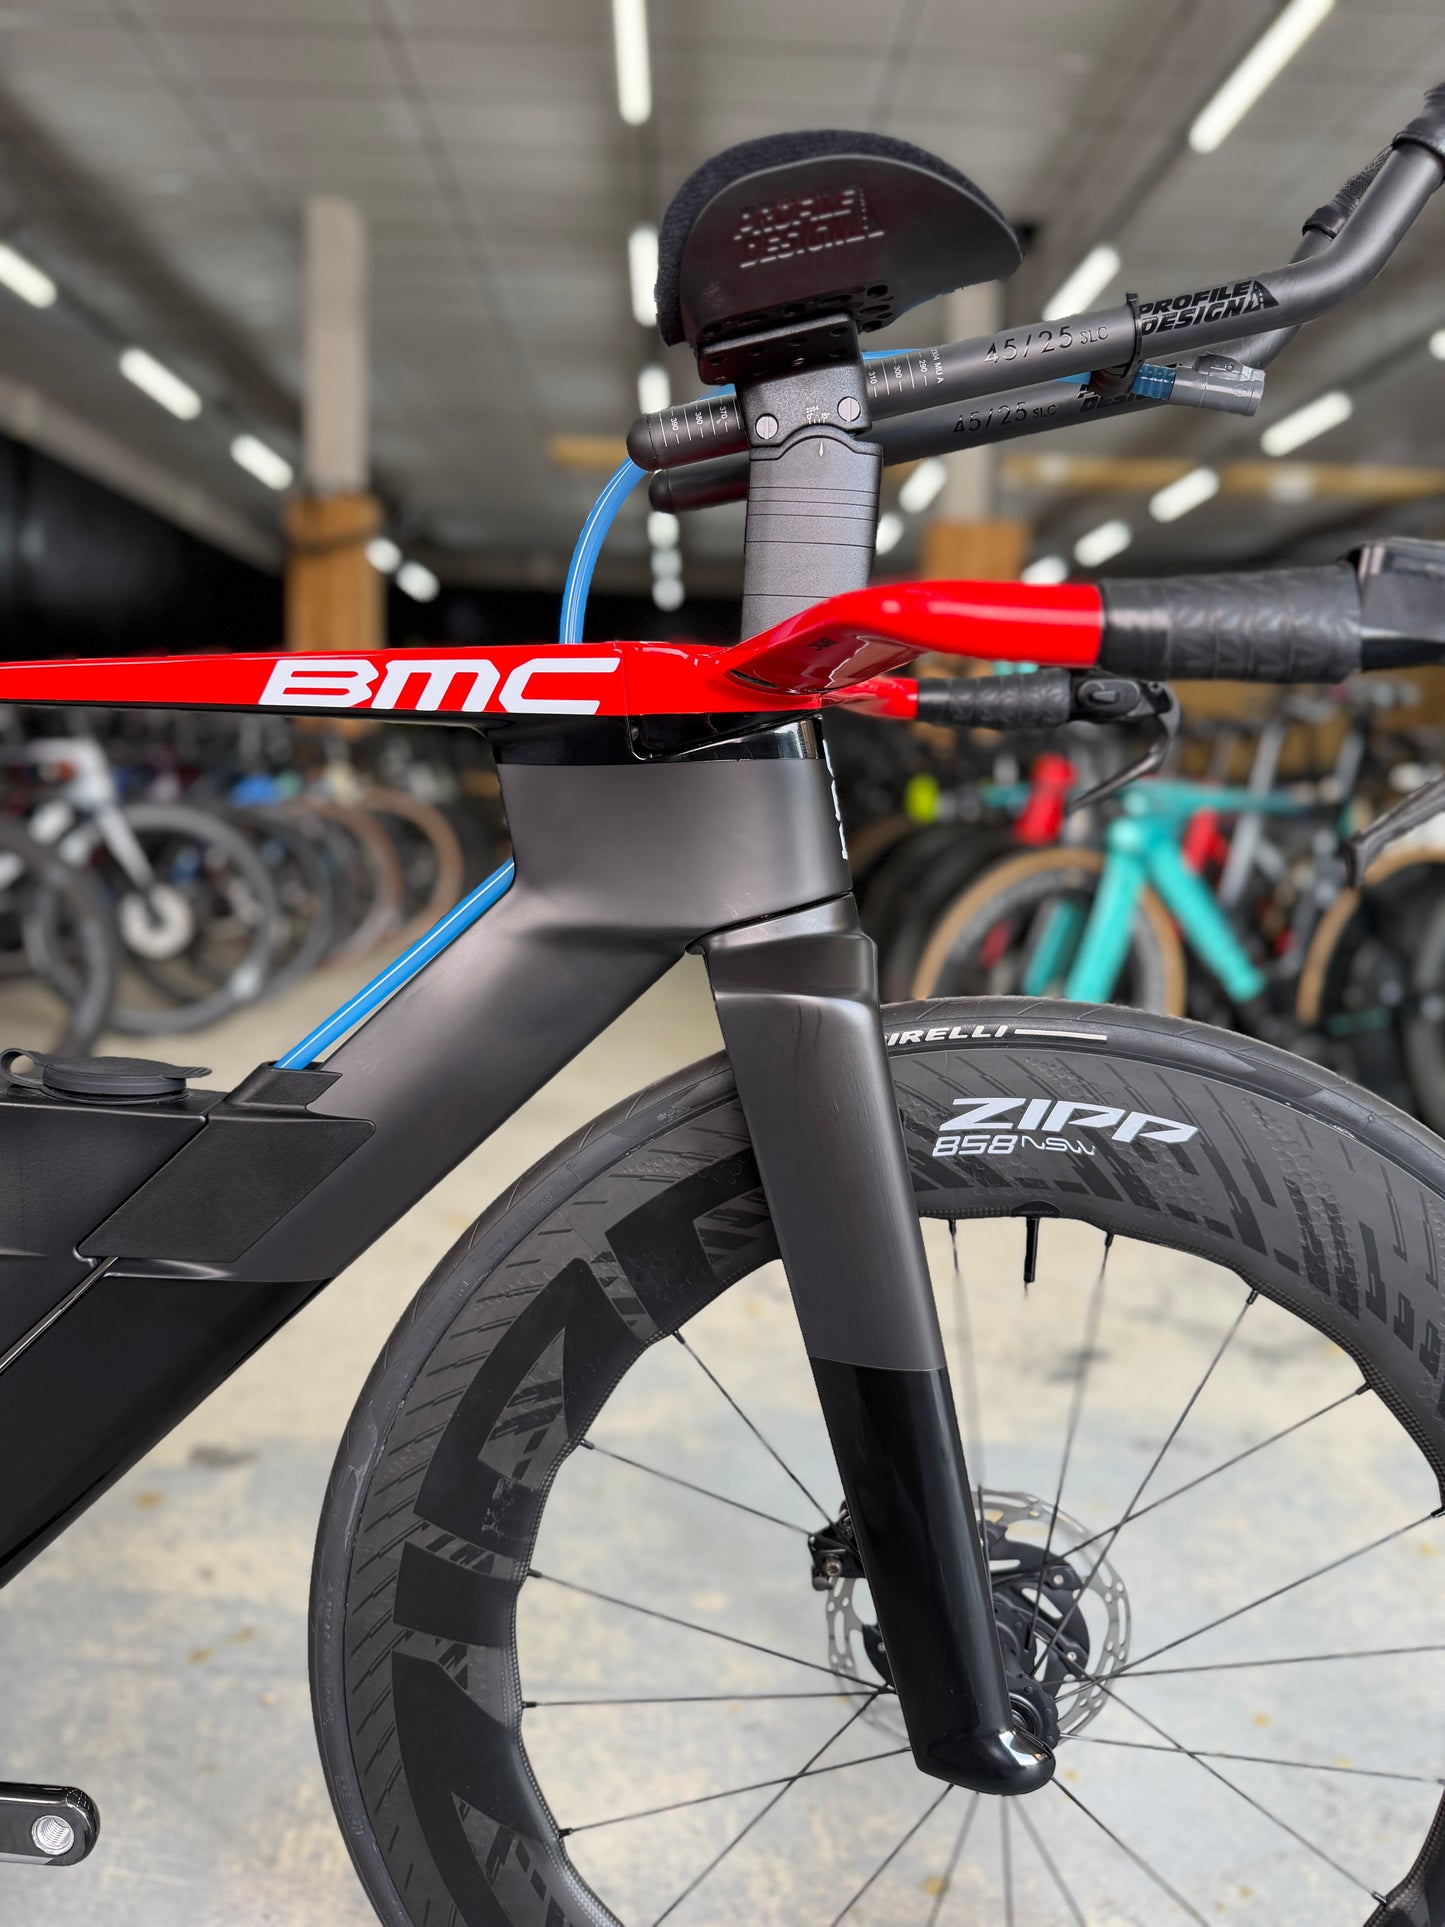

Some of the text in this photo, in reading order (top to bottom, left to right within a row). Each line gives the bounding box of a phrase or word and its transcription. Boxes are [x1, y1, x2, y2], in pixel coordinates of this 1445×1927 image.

[1138, 281, 1252, 316] PROFILE
[1141, 298, 1246, 336] DESIGN
[983, 325, 1108, 363] 45/25 SLC
[893, 365, 903, 379] 300
[918, 359, 928, 373] 290
[868, 371, 878, 385] 310
[670, 417, 680, 431] 390
[694, 411, 703, 425] 380
[952, 401, 1056, 435] 45/25 SLC
[258, 657, 621, 715] BMC
[884, 1025, 1008, 1046] IRELLI
[939, 1097, 1199, 1143] ZIPP
[931, 1134, 1018, 1157] 858
